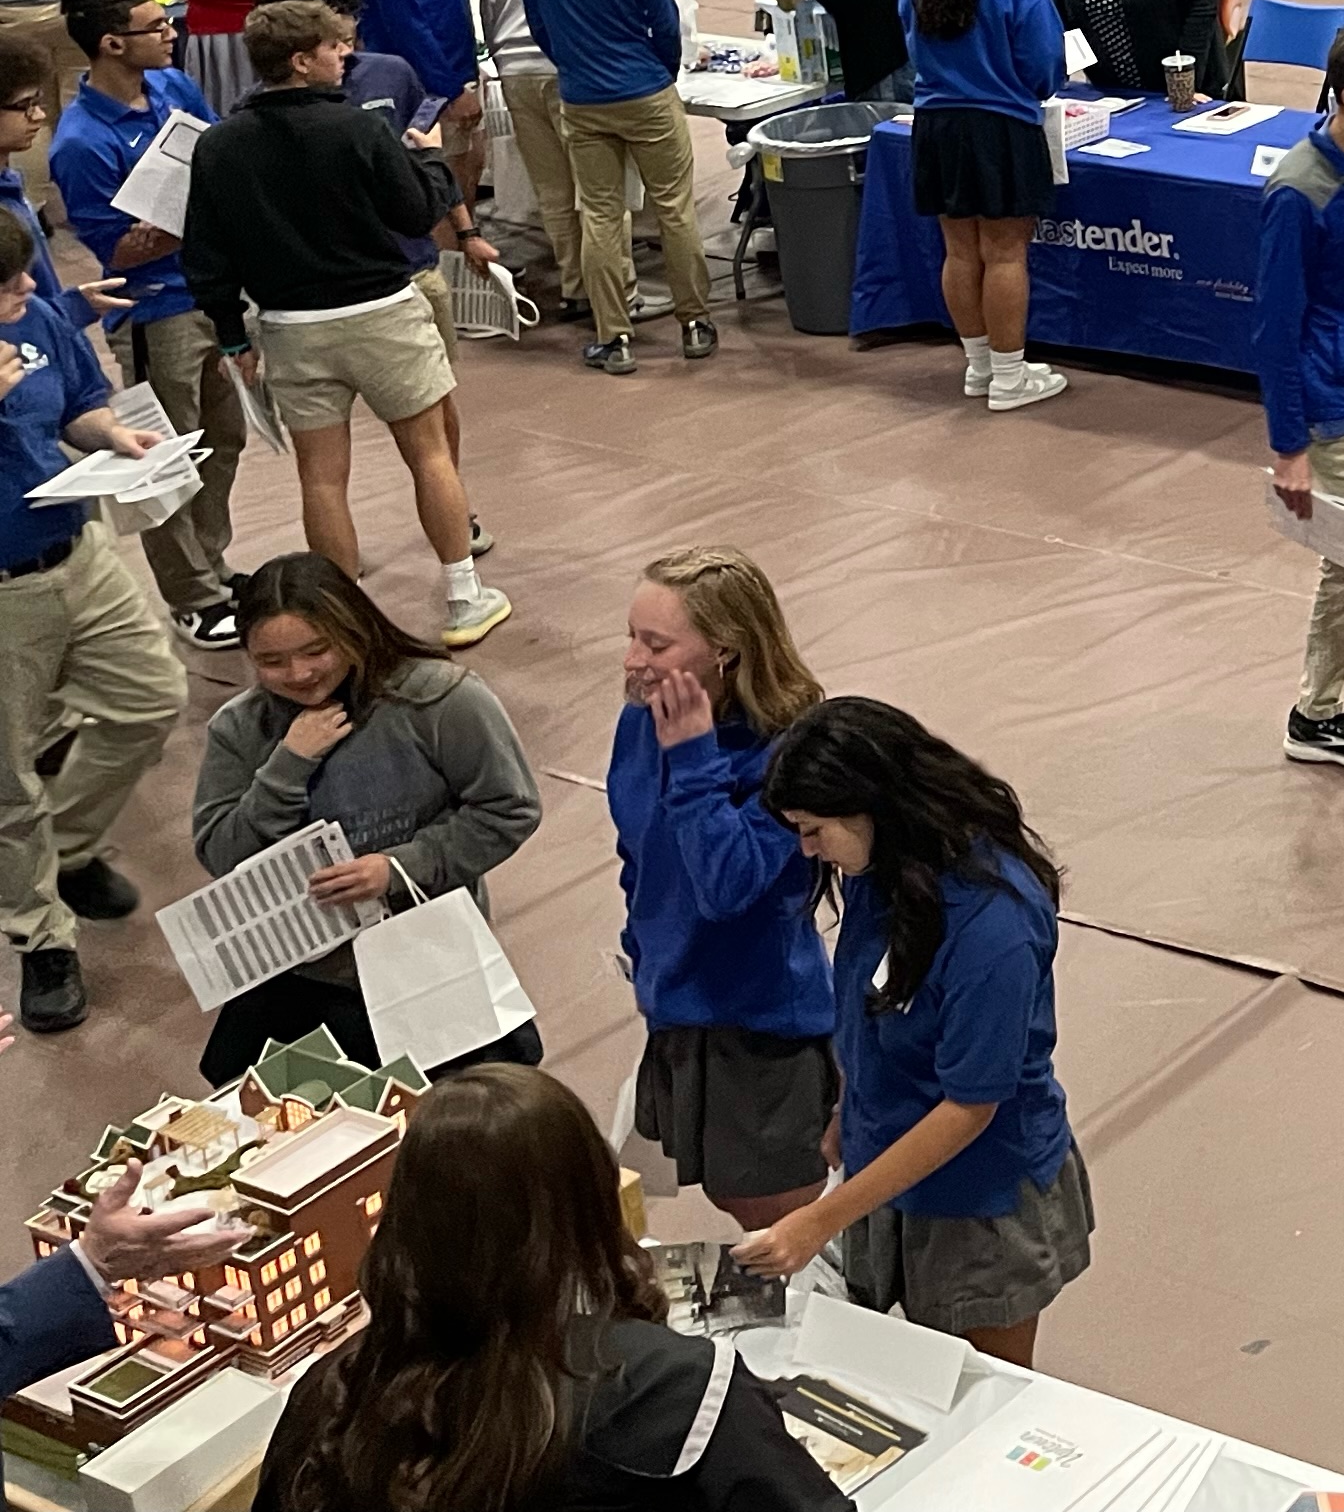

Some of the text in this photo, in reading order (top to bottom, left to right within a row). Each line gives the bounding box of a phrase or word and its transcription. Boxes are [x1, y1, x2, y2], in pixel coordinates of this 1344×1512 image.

[1031, 218, 1180, 261] astender.
[1108, 256, 1184, 281] Expect more
